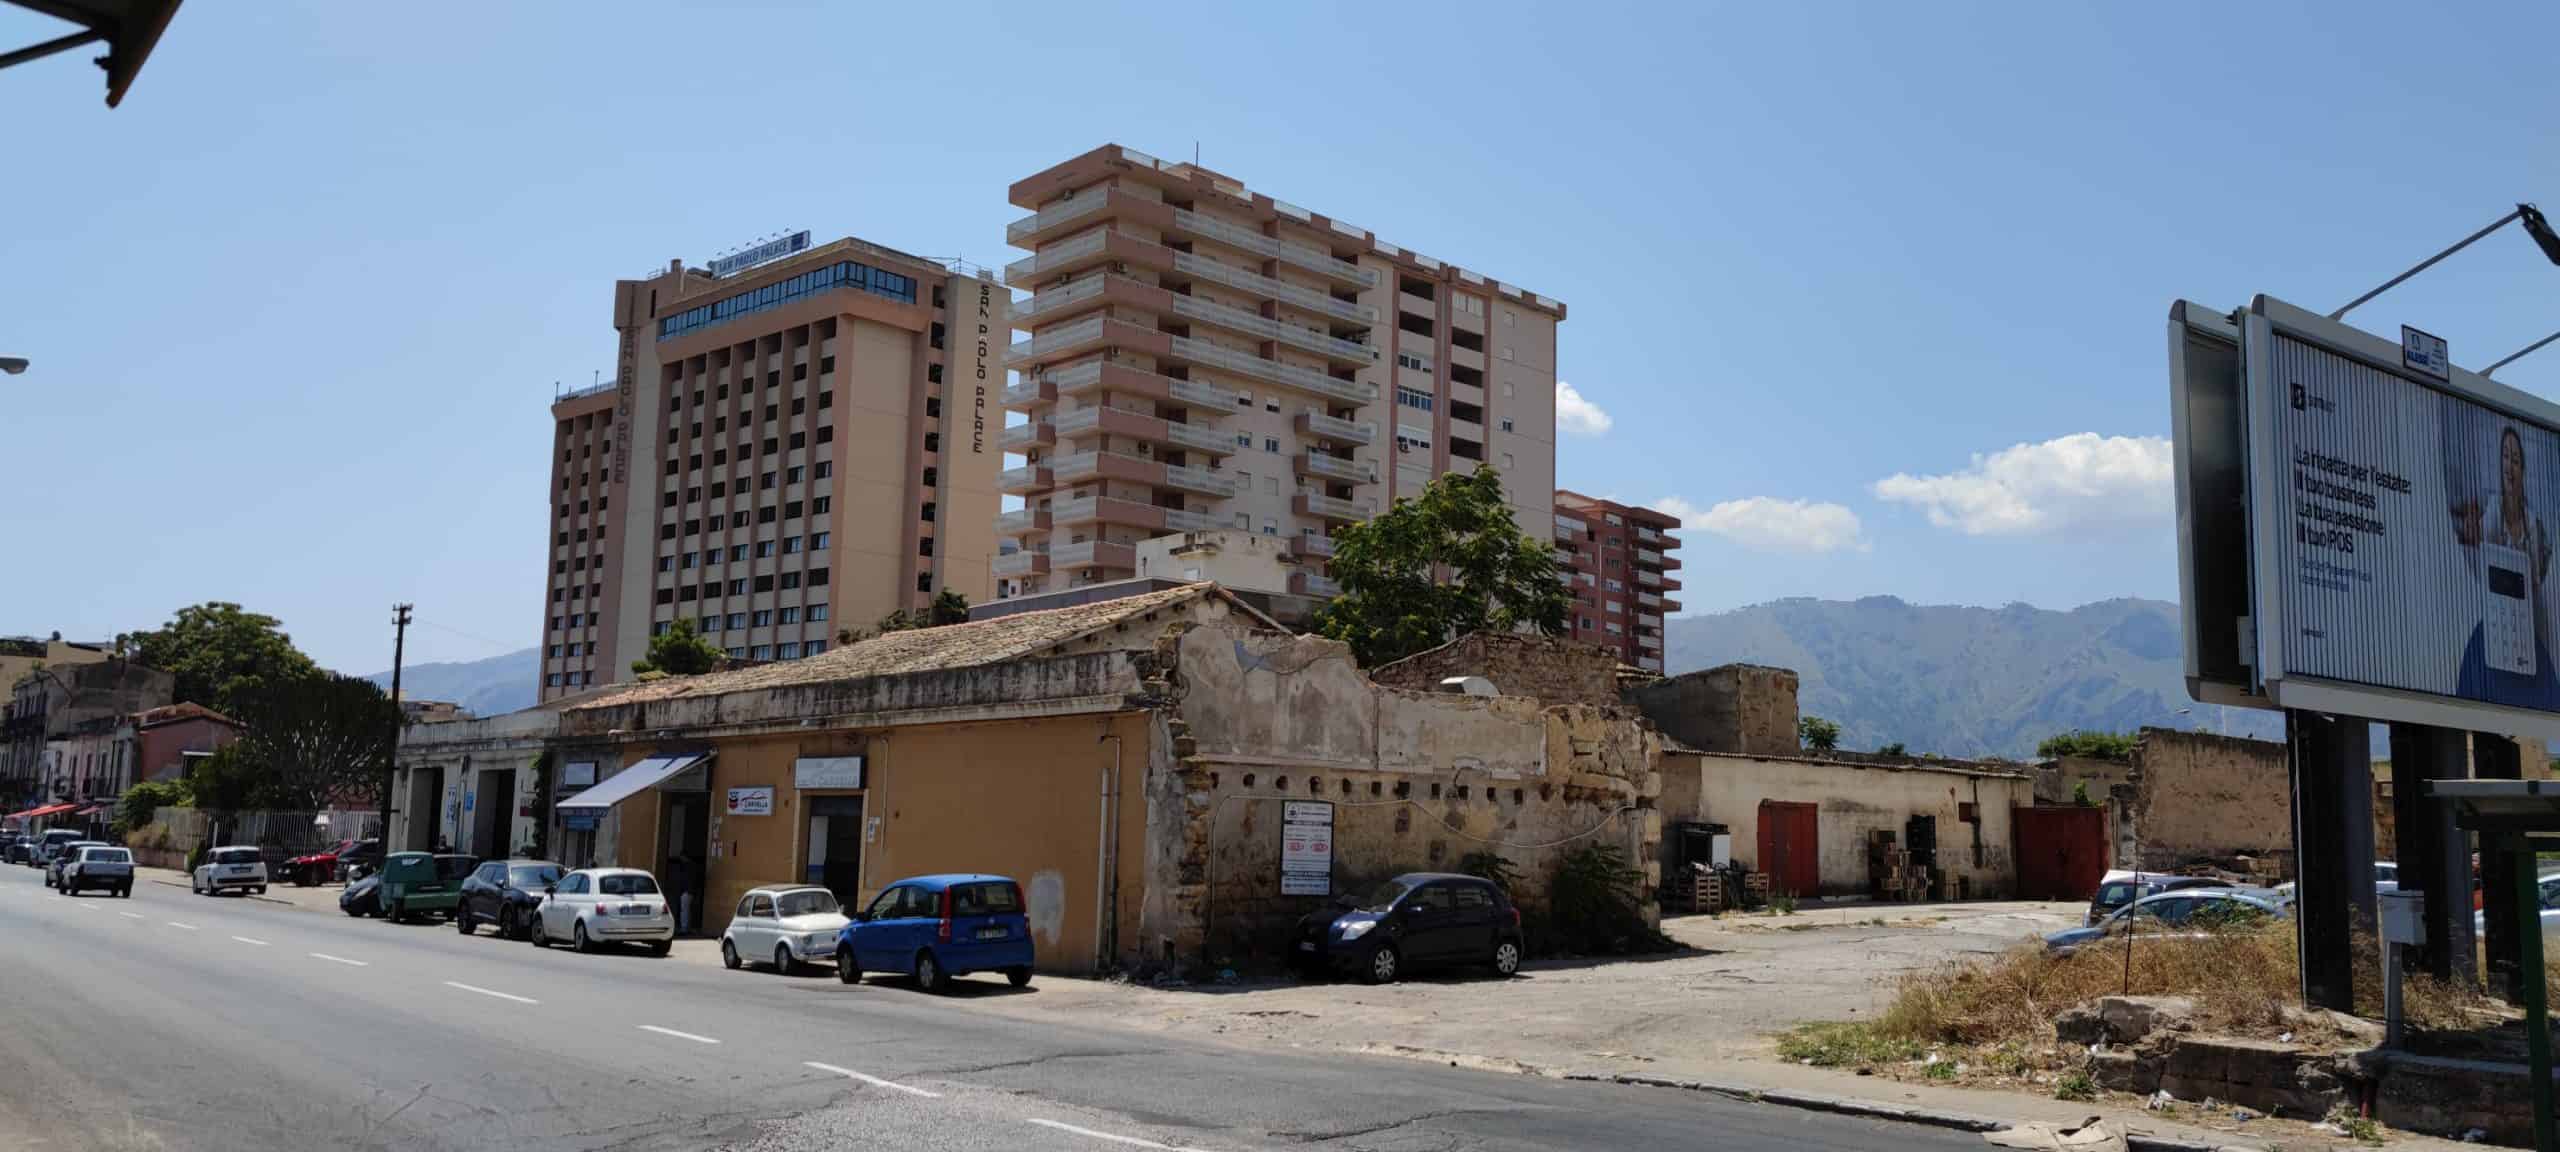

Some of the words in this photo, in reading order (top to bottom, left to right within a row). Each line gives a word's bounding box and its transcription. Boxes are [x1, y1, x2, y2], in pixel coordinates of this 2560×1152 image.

[979, 284, 990, 318] SAN
[976, 324, 988, 380] PAOLO
[973, 384, 985, 453] PALACE
[2351, 464, 2369, 482] per
[2325, 480, 2377, 511] business
[2336, 510, 2385, 537] passione
[2328, 530, 2354, 554] POS
